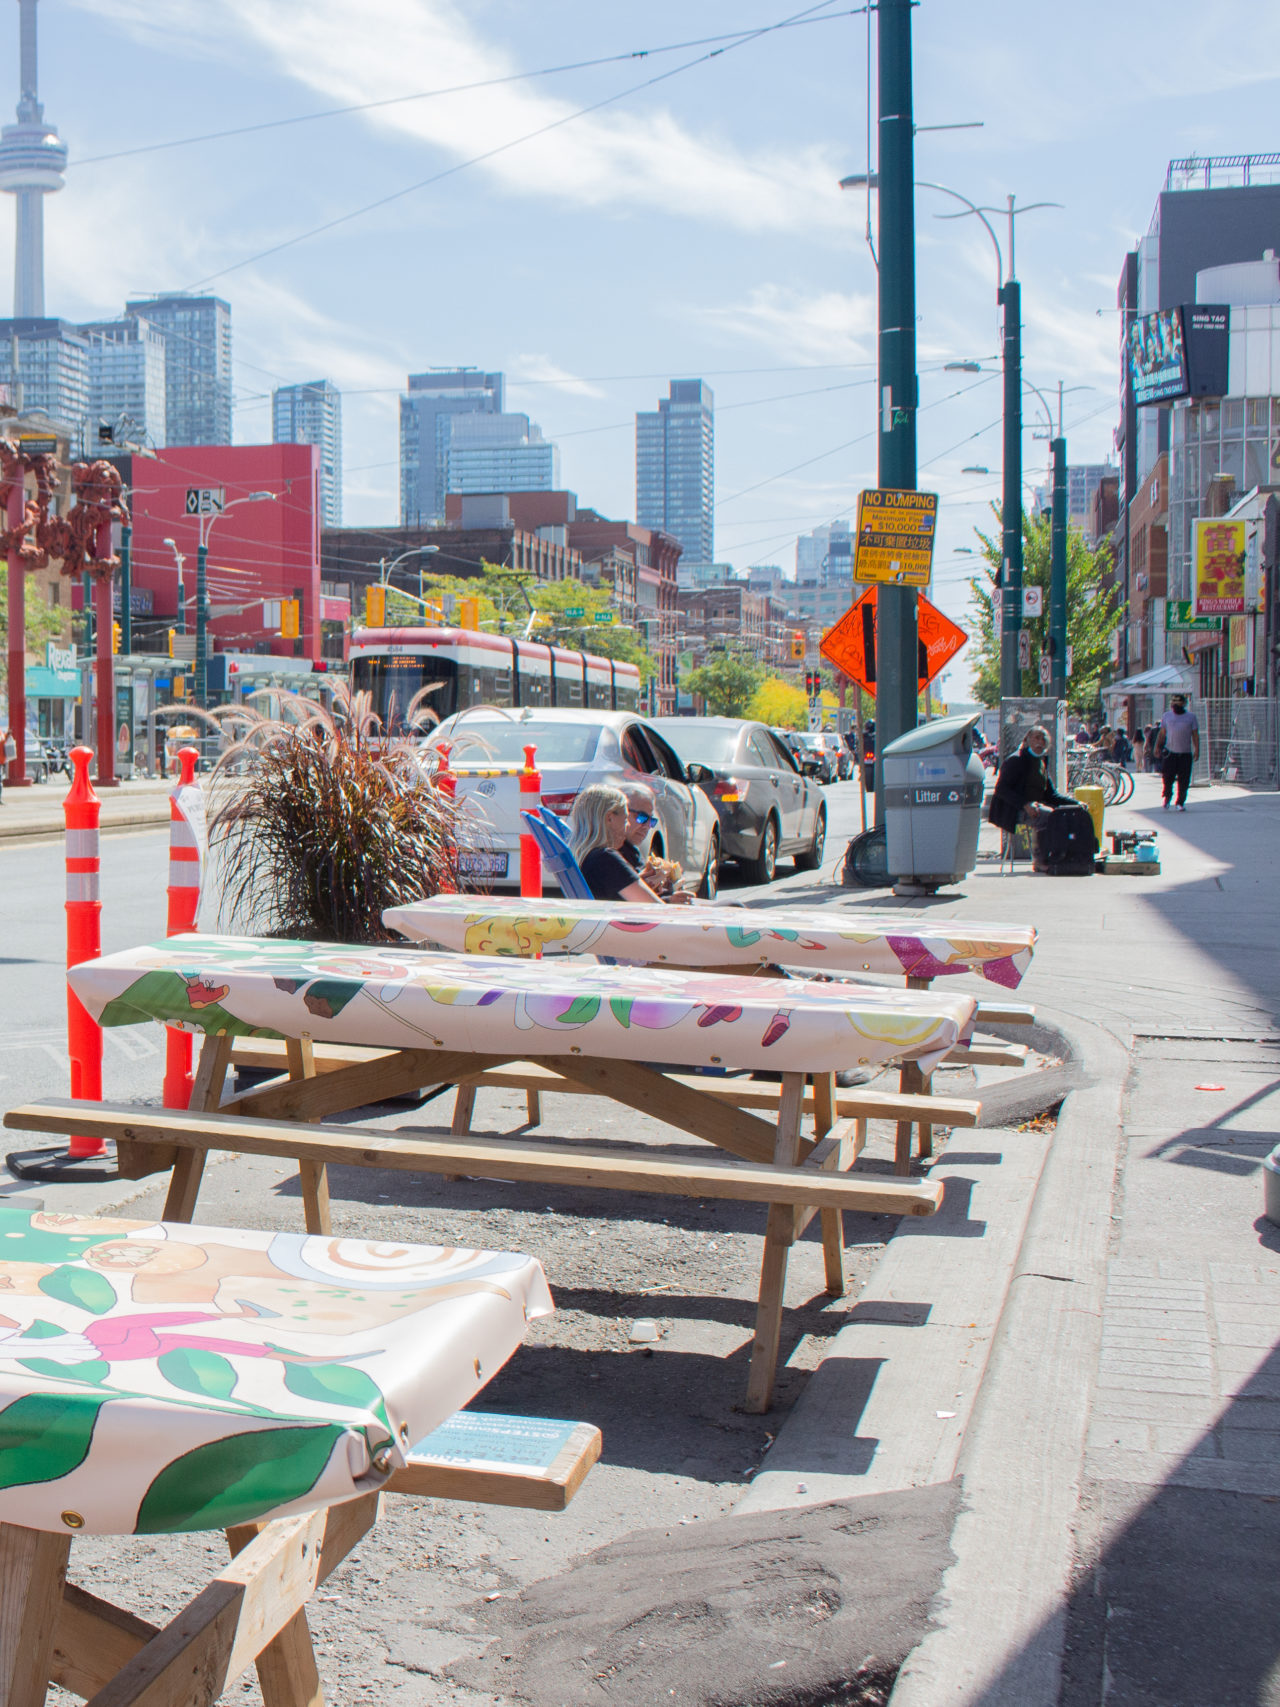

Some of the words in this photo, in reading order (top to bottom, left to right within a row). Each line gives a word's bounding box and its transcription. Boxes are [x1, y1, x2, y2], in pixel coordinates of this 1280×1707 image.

[1210, 315, 1226, 323] TAO
[865, 492, 881, 505] NO
[885, 493, 935, 508] DUMPING
[872, 513, 906, 521] Maximum
[878, 522, 917, 532] $10,000
[48, 642, 77, 671] Rexall
[915, 790, 941, 802] Litter
